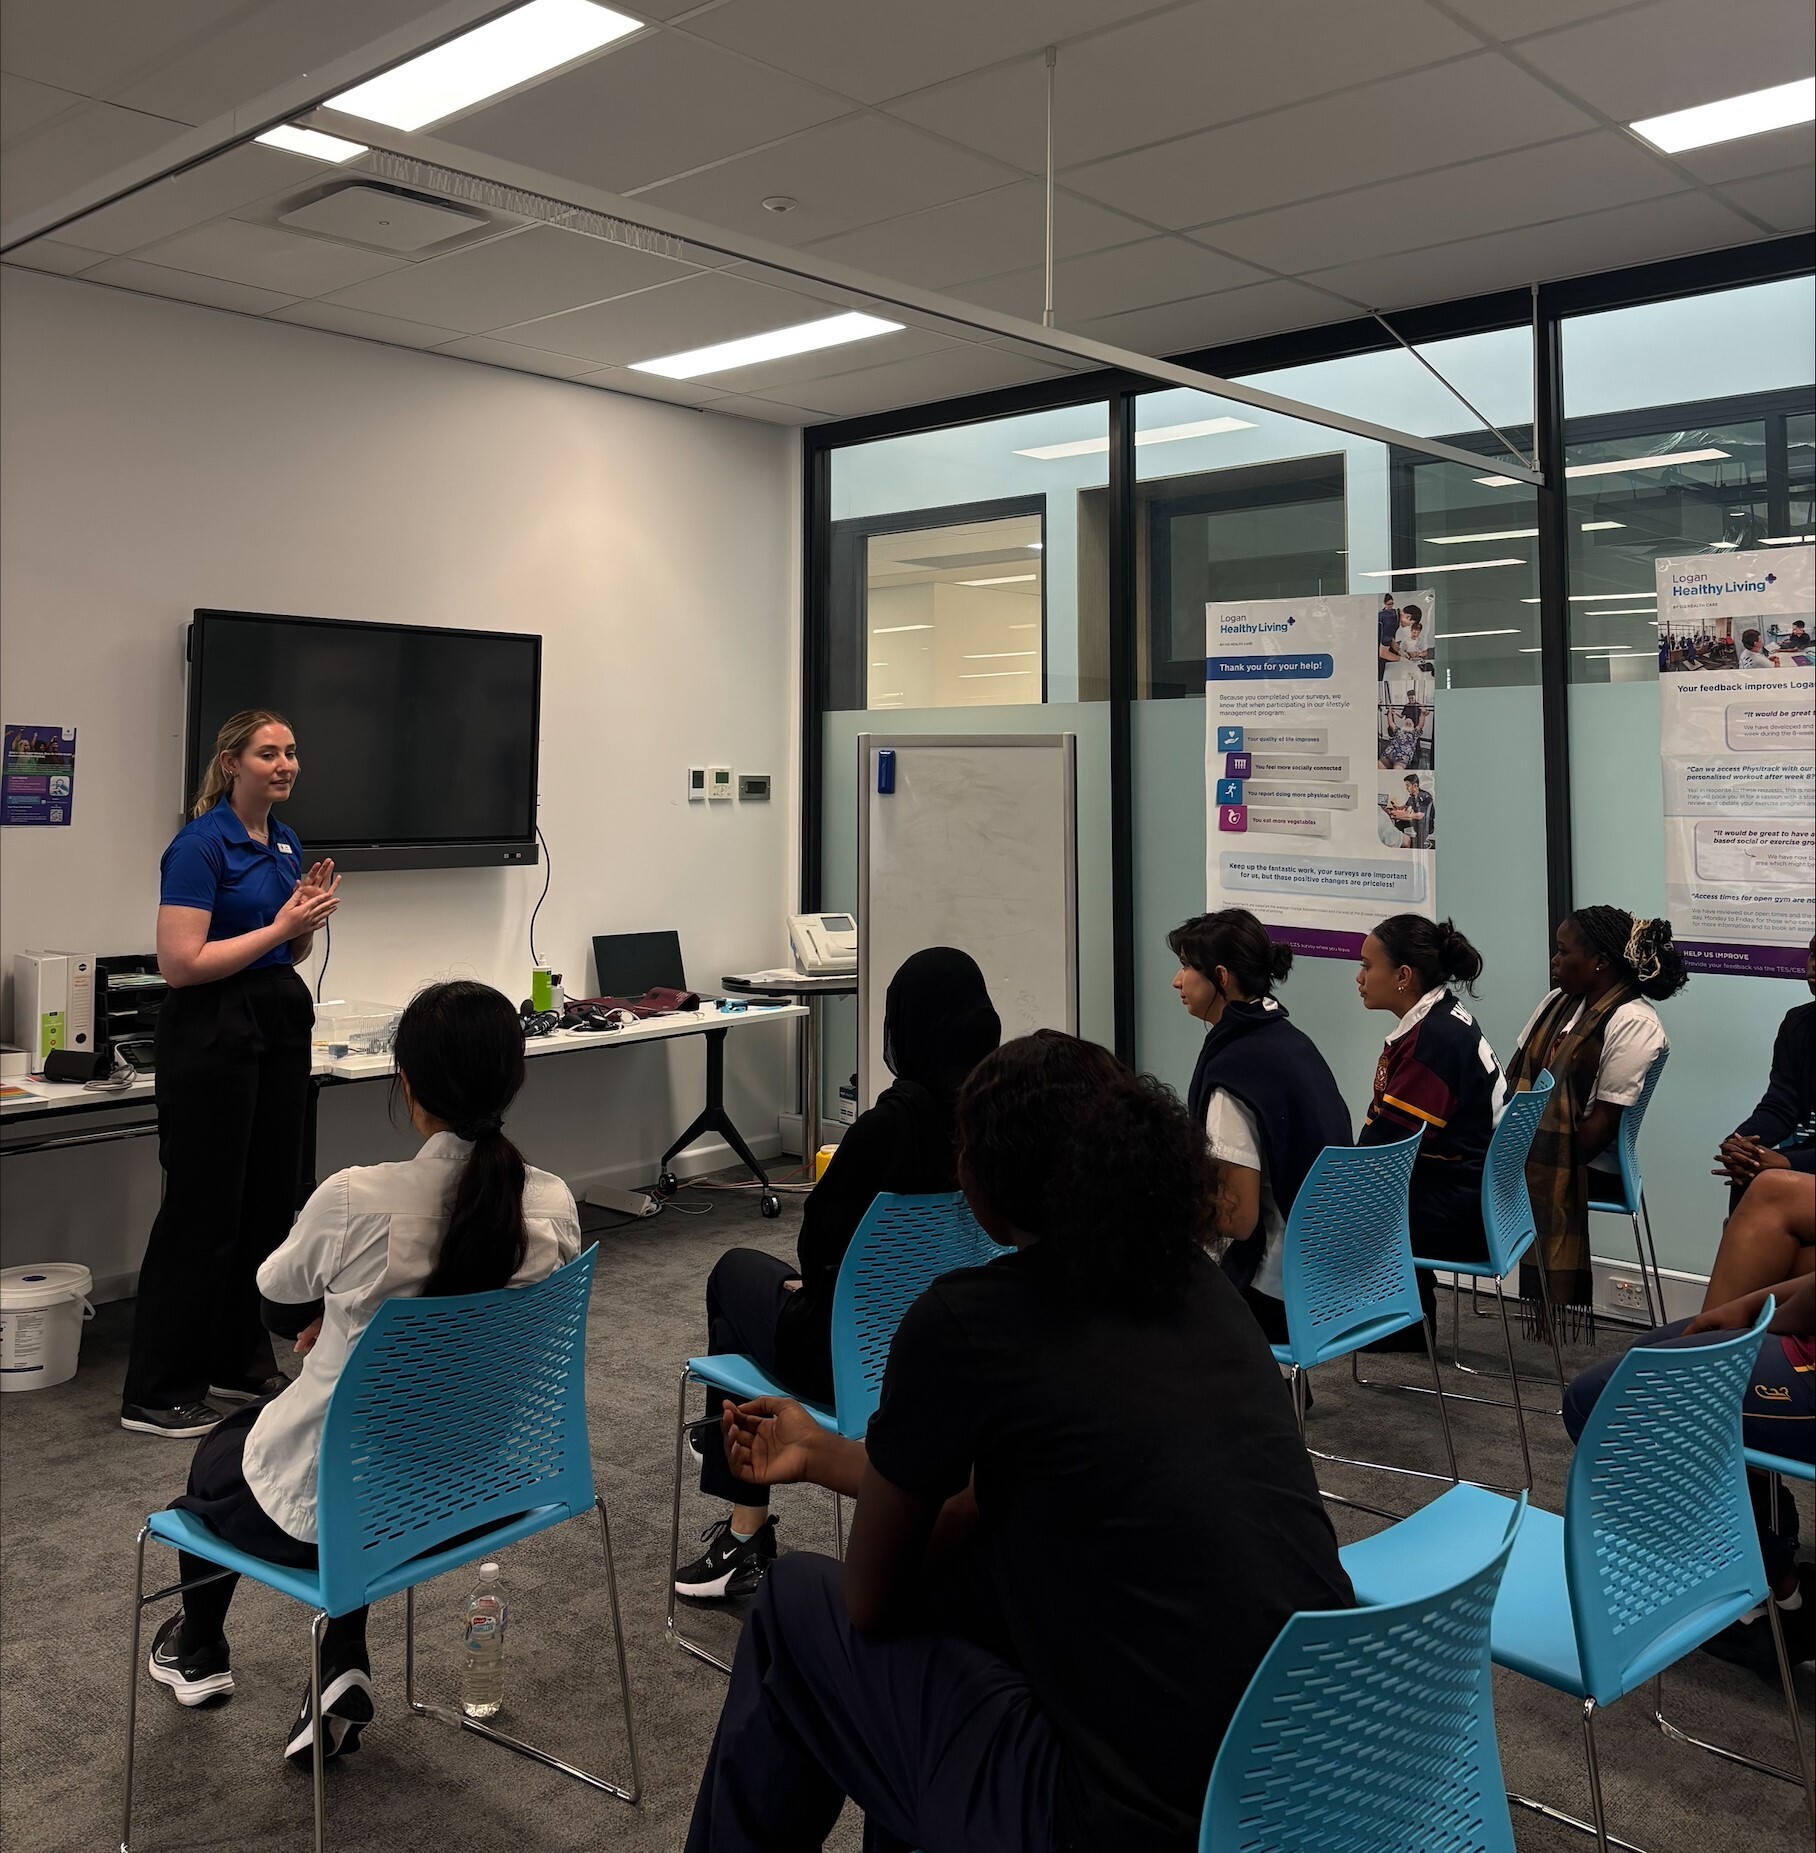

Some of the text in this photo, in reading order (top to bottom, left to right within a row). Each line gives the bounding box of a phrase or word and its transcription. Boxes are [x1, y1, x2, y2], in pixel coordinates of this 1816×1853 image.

[1672, 573, 1708, 584] Logan
[1673, 580, 1766, 596] Healthy Living
[1220, 614, 1247, 623] Logan
[1220, 623, 1288, 634] Healthy Living
[1219, 663, 1245, 672] Thank
[1264, 662, 1277, 670] for
[1278, 663, 1298, 672] your
[1300, 661, 1322, 671] help!
[1678, 685, 1698, 693] Your
[1700, 683, 1742, 692] feedback
[1744, 682, 1788, 691] improves
[1742, 765, 1781, 773] Physitrack
[1769, 838, 1800, 846] exercise
[1788, 860, 1806, 868] might
[1229, 862, 1245, 870] Keep
[1268, 865, 1296, 873] fantastic
[1317, 868, 1333, 876] your
[1373, 871, 1408, 880] important
[1293, 875, 1319, 883] positive
[1321, 877, 1348, 885] changes
[1362, 880, 1395, 888] priceless!
[1715, 952, 1750, 961] IMPROVE
[1723, 962, 1752, 970] feedback
[1776, 966, 1806, 974] TES/CES
